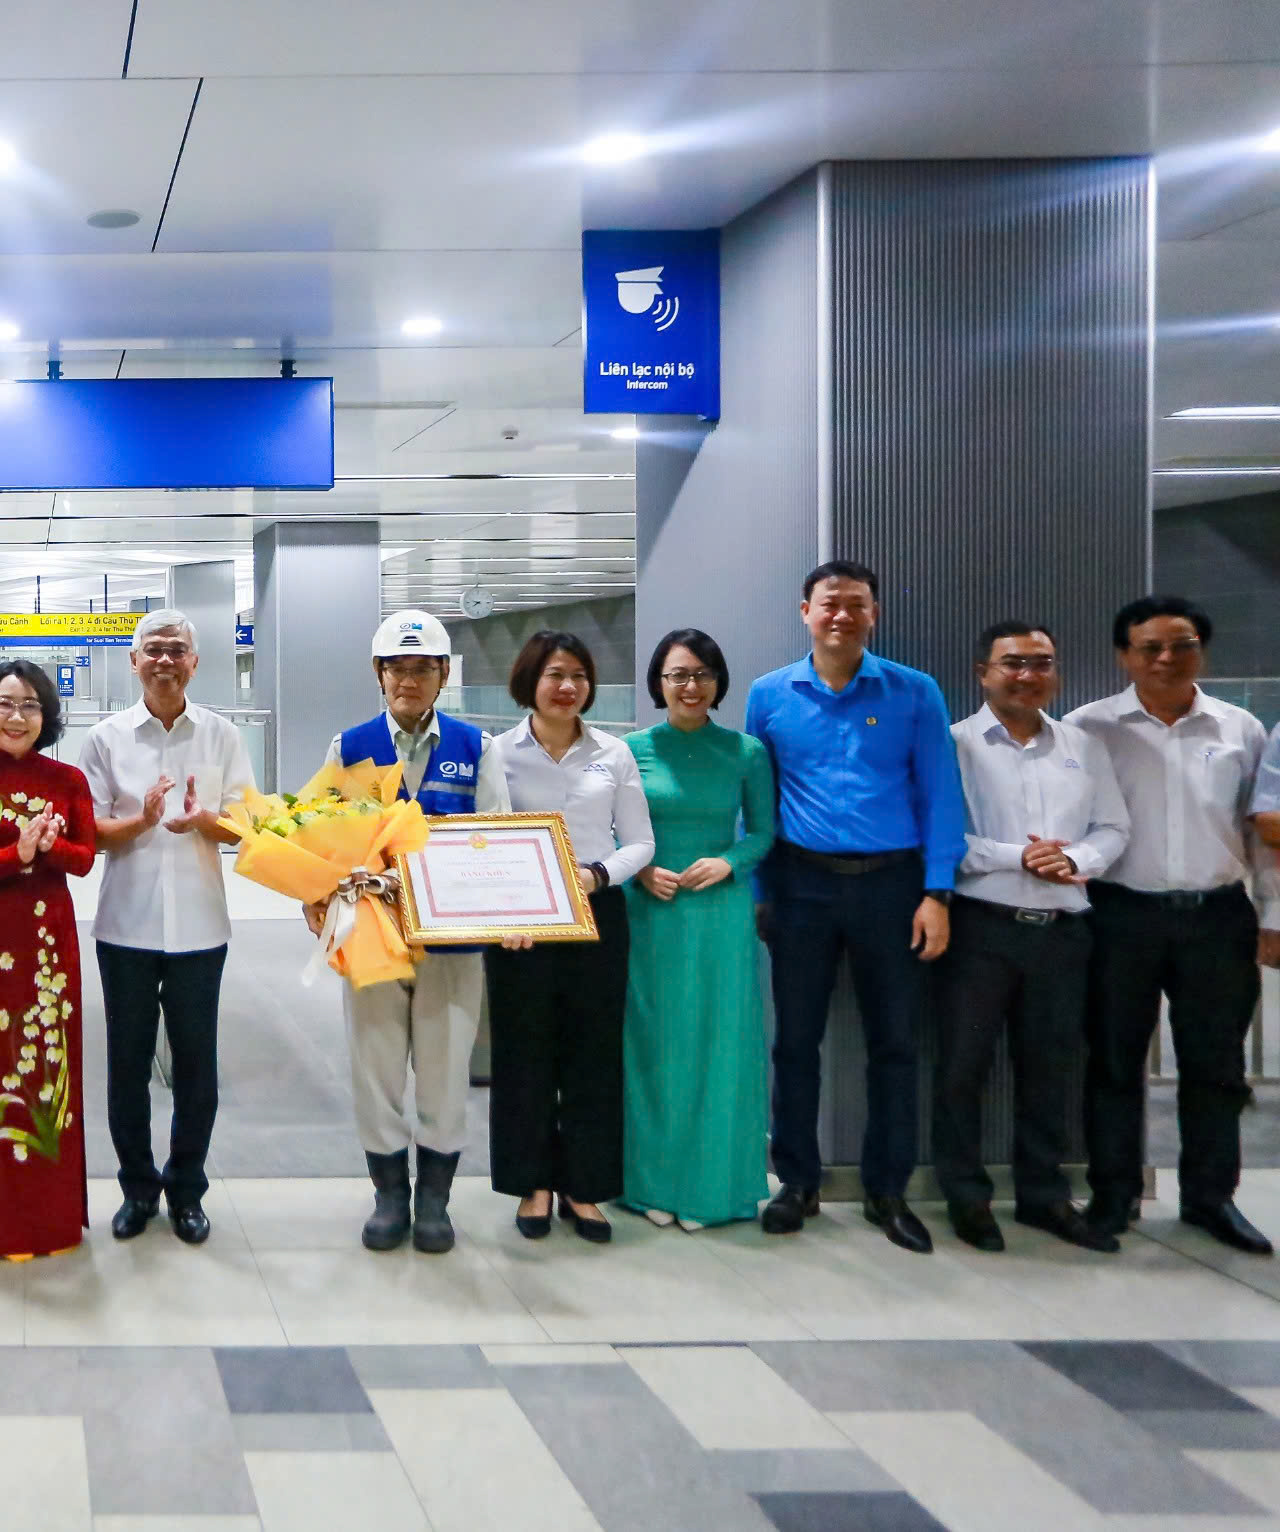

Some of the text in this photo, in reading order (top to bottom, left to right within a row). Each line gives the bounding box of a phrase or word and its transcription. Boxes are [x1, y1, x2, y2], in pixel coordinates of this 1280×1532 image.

[600, 362, 695, 379] Liên lạc nội bộ
[626, 379, 668, 390] Intercom
